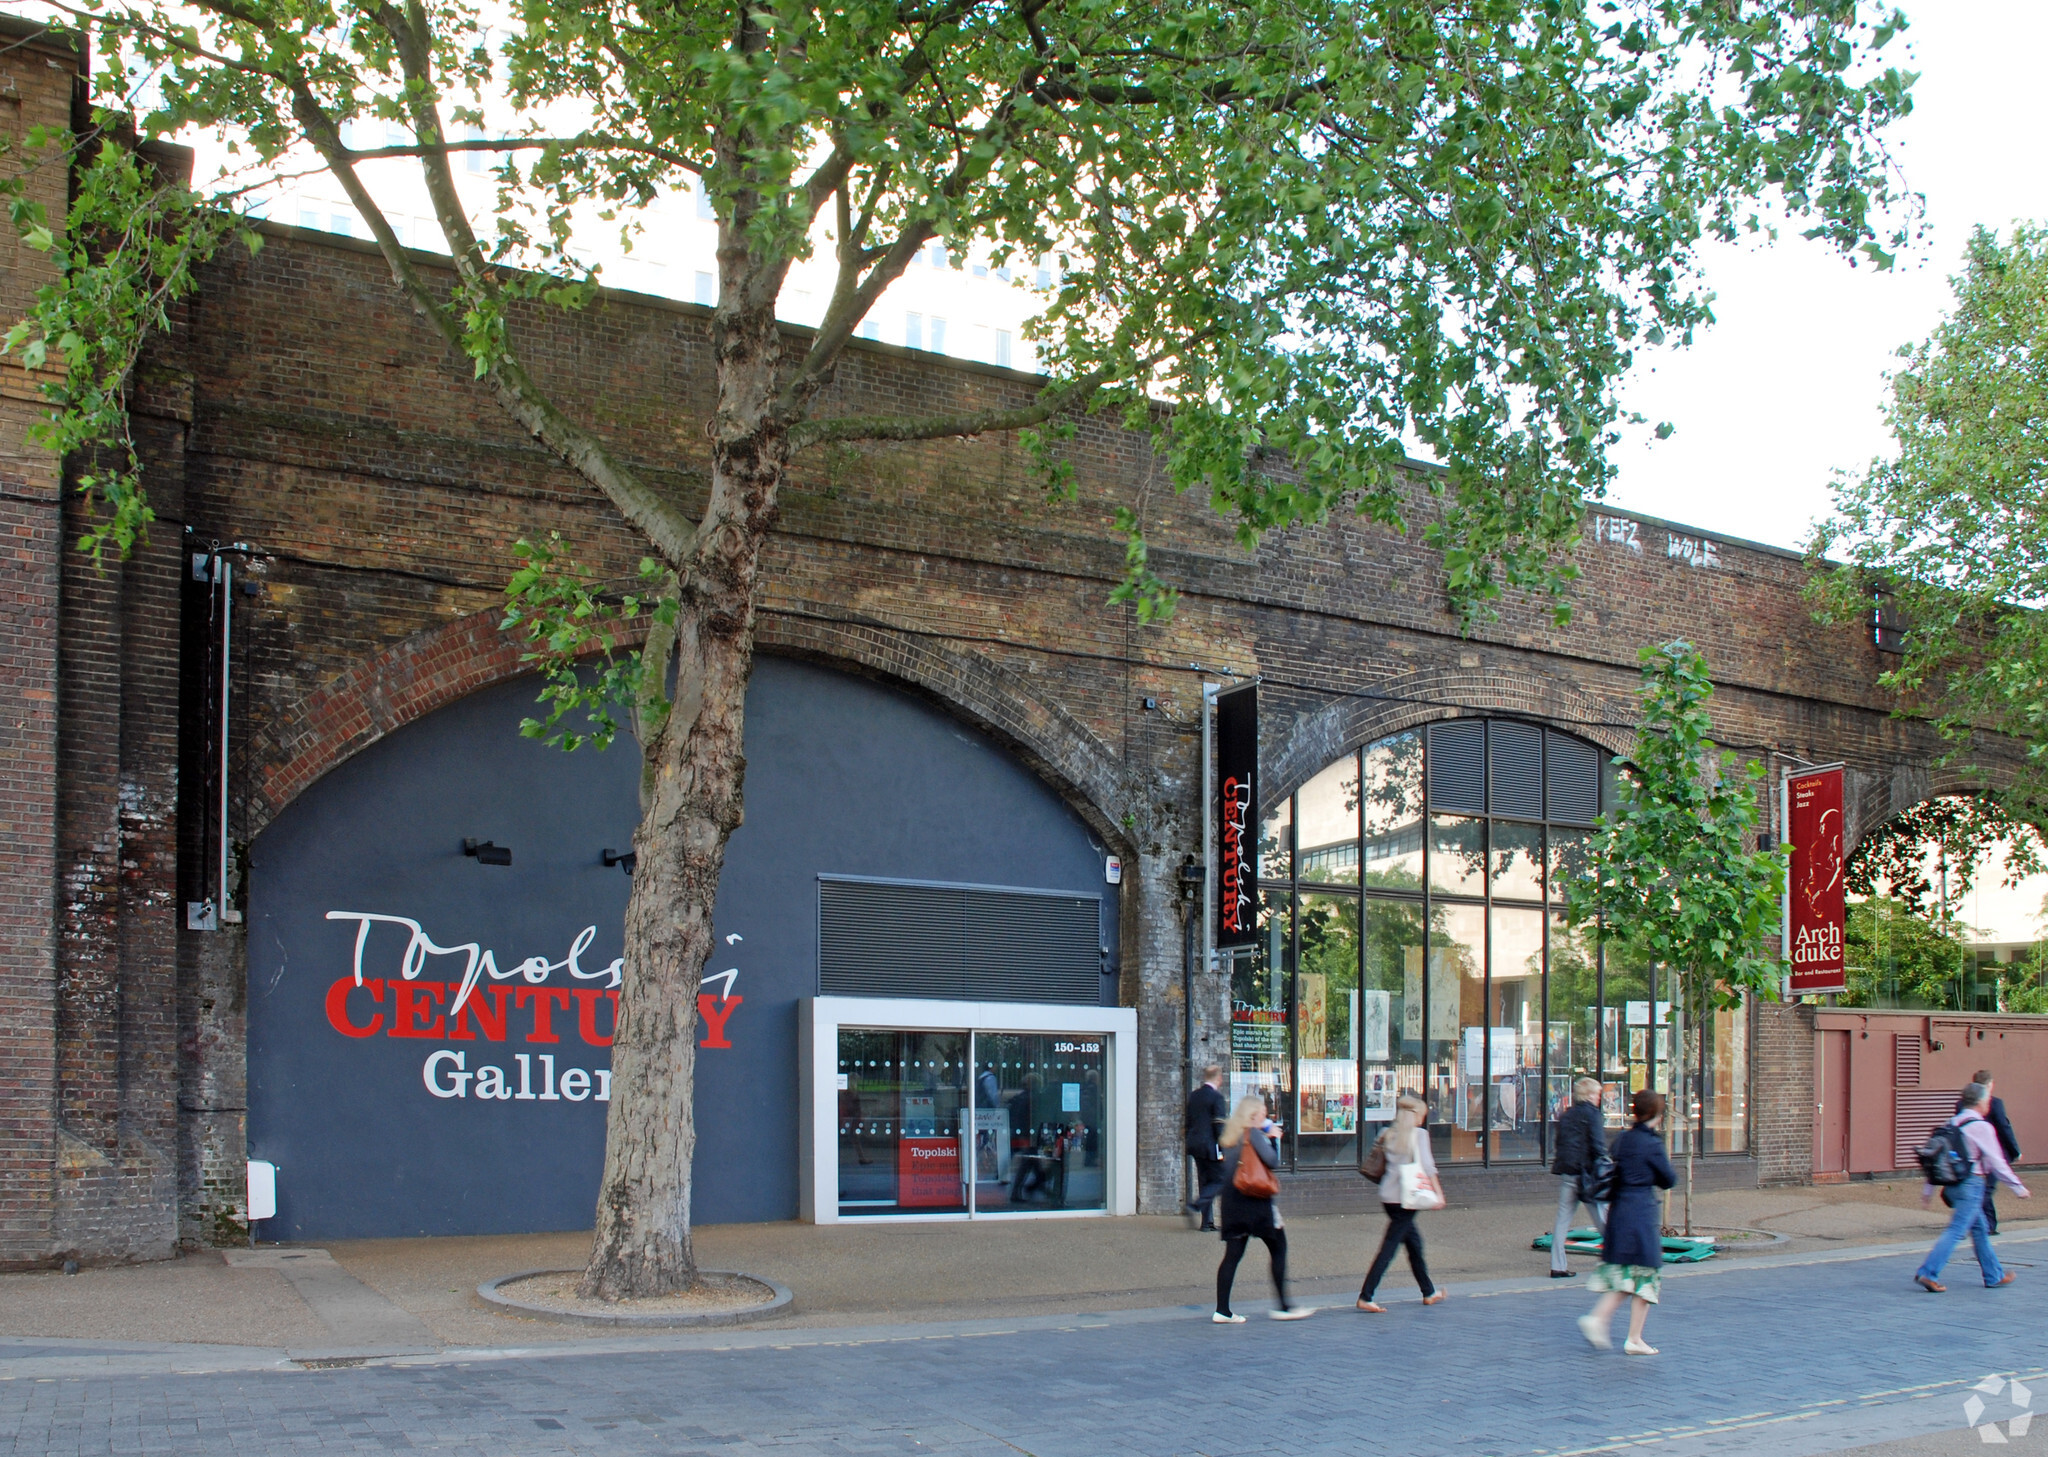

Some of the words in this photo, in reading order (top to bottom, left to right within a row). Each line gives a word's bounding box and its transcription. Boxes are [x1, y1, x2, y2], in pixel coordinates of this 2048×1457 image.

[1796, 779, 1822, 789] Cocktails
[1796, 789, 1815, 799] Steaks
[1223, 776, 1238, 934] CENTURY
[1228, 772, 1252, 932] Topolski
[1795, 921, 1840, 945] Arch
[326, 911, 743, 1015] Topolsi
[1795, 942, 1841, 963] duke
[326, 976, 743, 1049] CENTUY
[1233, 1000, 1286, 1016] Topolski
[1233, 1010, 1287, 1022] CENTURY
[1054, 1042, 1100, 1053] 150-152
[423, 1050, 612, 1101] Galler
[911, 1147, 957, 1159] Topolski
